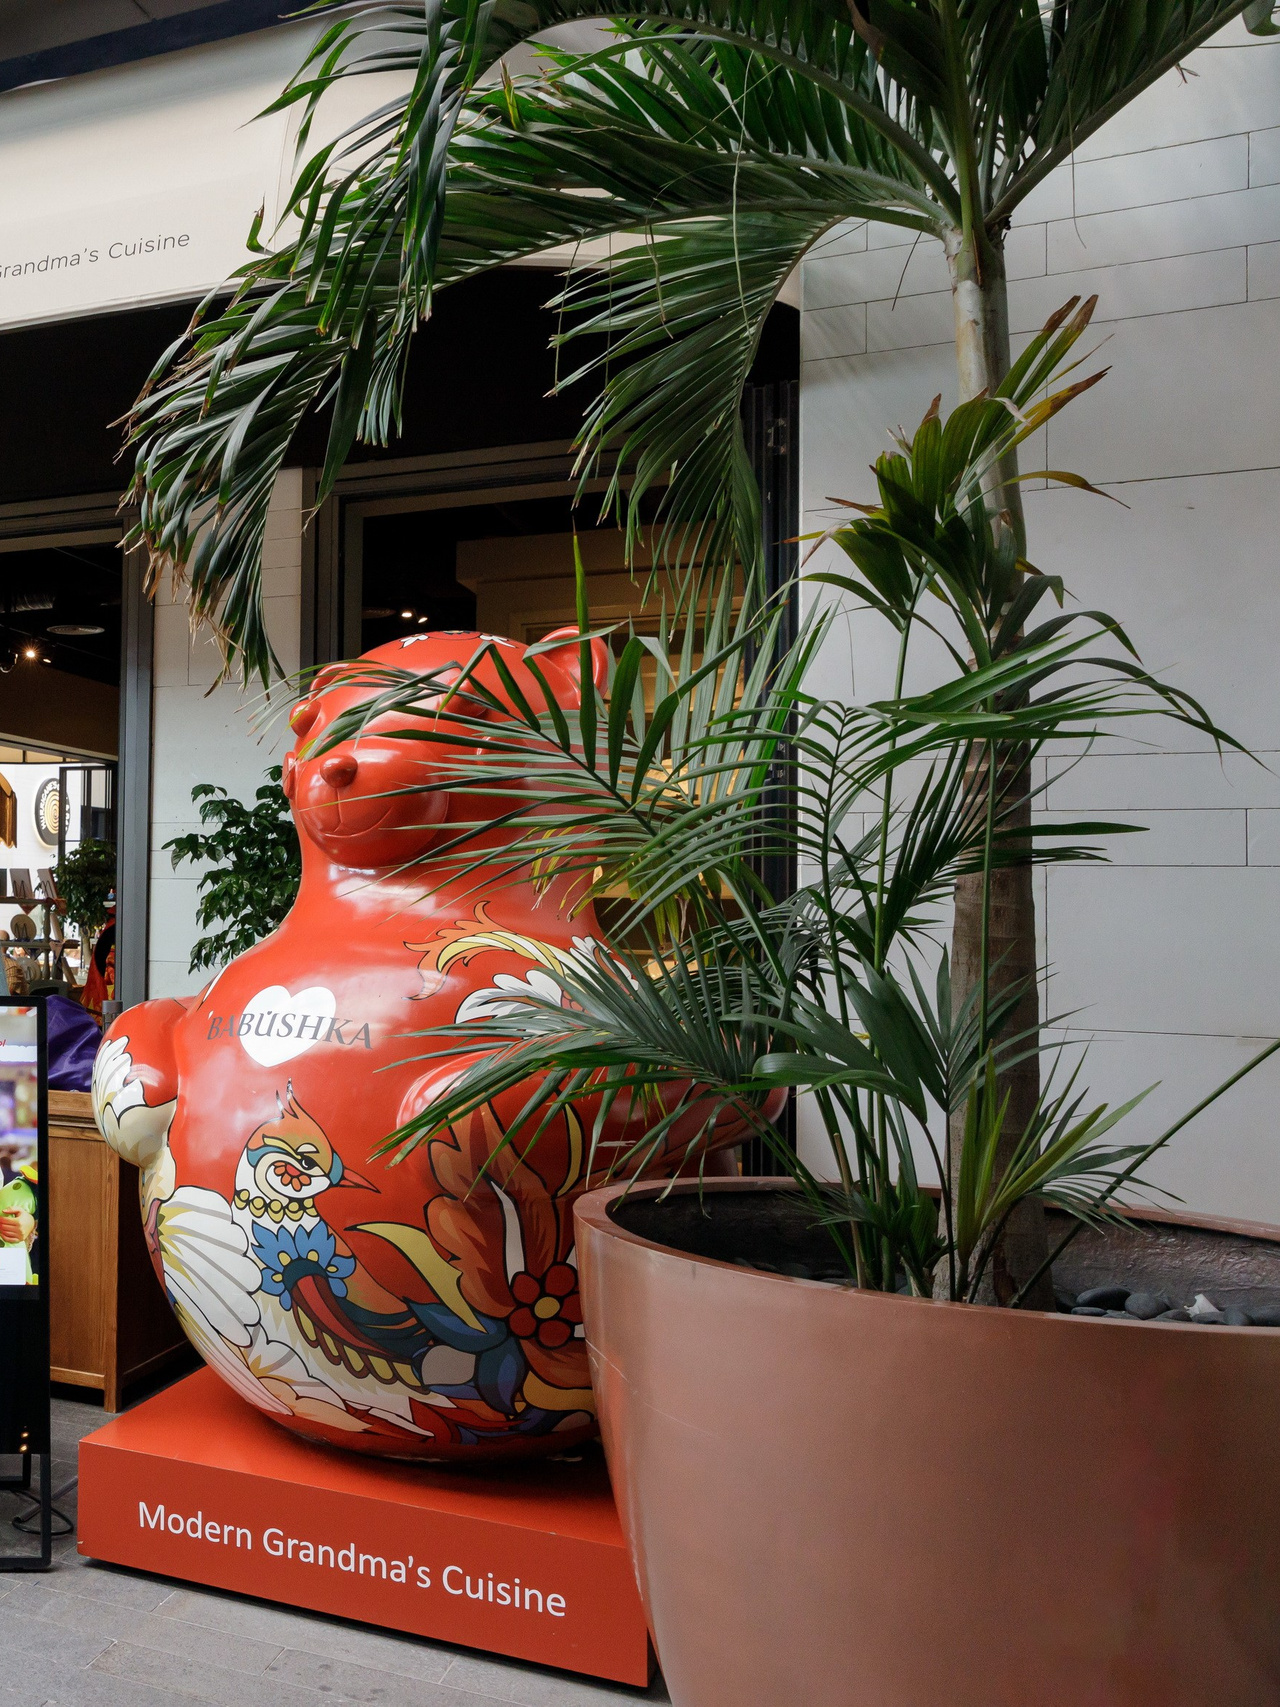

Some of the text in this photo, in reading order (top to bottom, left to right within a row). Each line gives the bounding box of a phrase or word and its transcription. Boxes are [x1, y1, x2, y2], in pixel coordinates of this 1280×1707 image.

[108, 233, 190, 259] Cuisine
[138, 1501, 253, 1550] Modern
[442, 1565, 567, 1618] Cuisine
